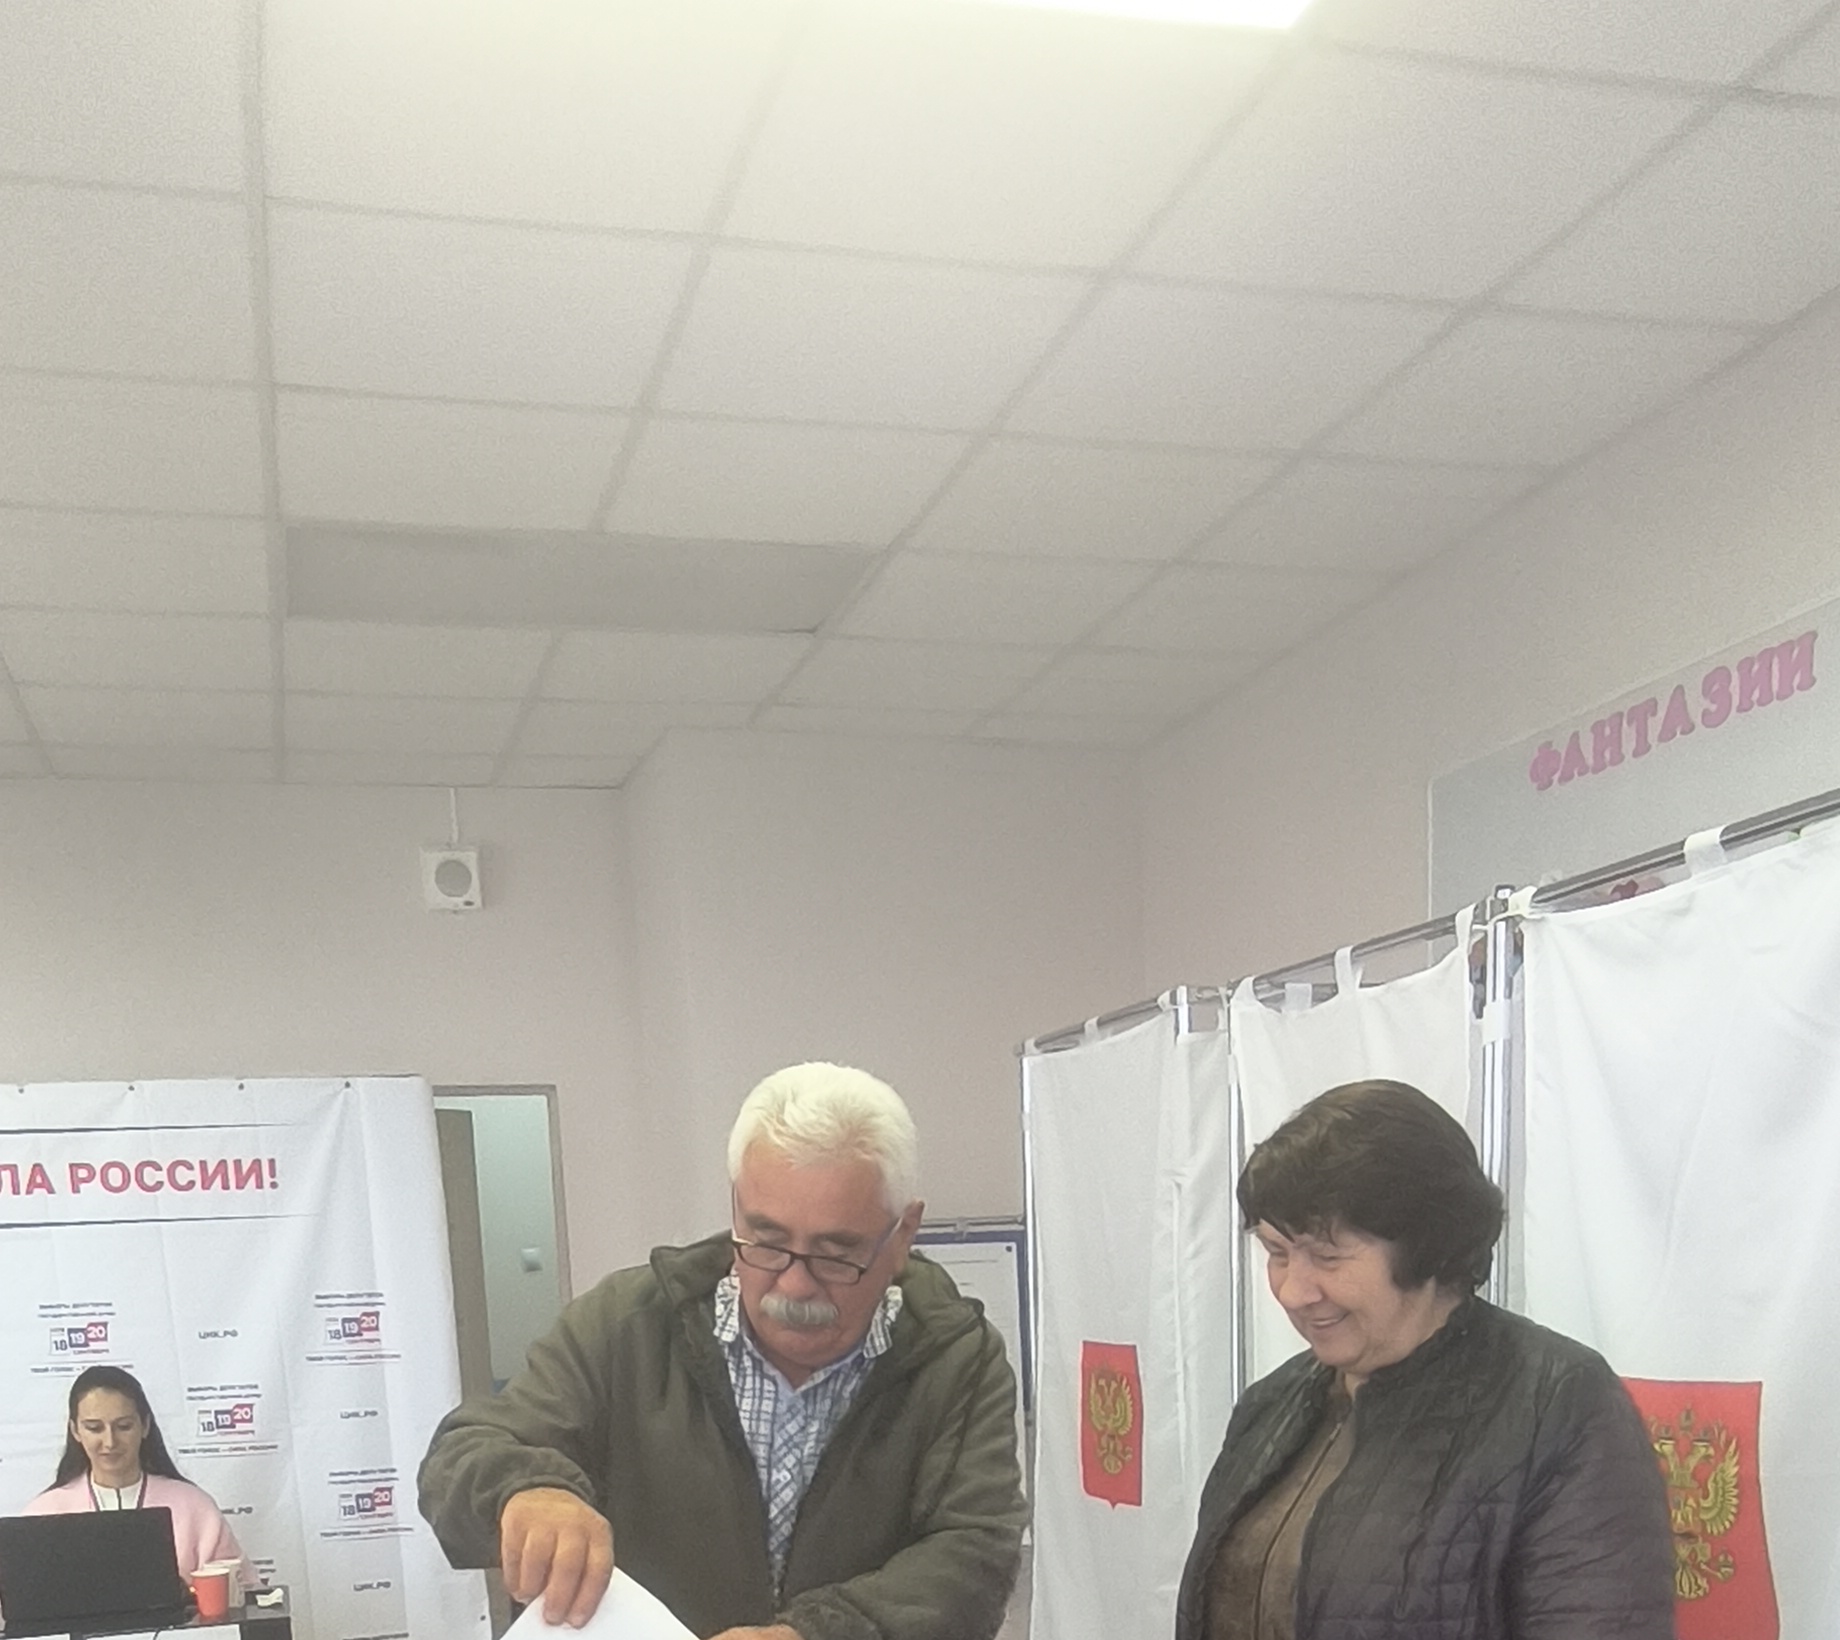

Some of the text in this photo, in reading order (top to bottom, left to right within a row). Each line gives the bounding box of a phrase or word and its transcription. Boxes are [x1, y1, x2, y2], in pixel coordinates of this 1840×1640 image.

[1529, 630, 1818, 791] ФАНТАЗИИ
[68, 1158, 279, 1195] РОССИИ!
[344, 1322, 359, 1334] 19
[361, 1316, 378, 1329] 20
[70, 1332, 86, 1345] 19
[87, 1326, 106, 1339] 20
[233, 1408, 252, 1421] 20
[374, 1491, 391, 1504] 20
